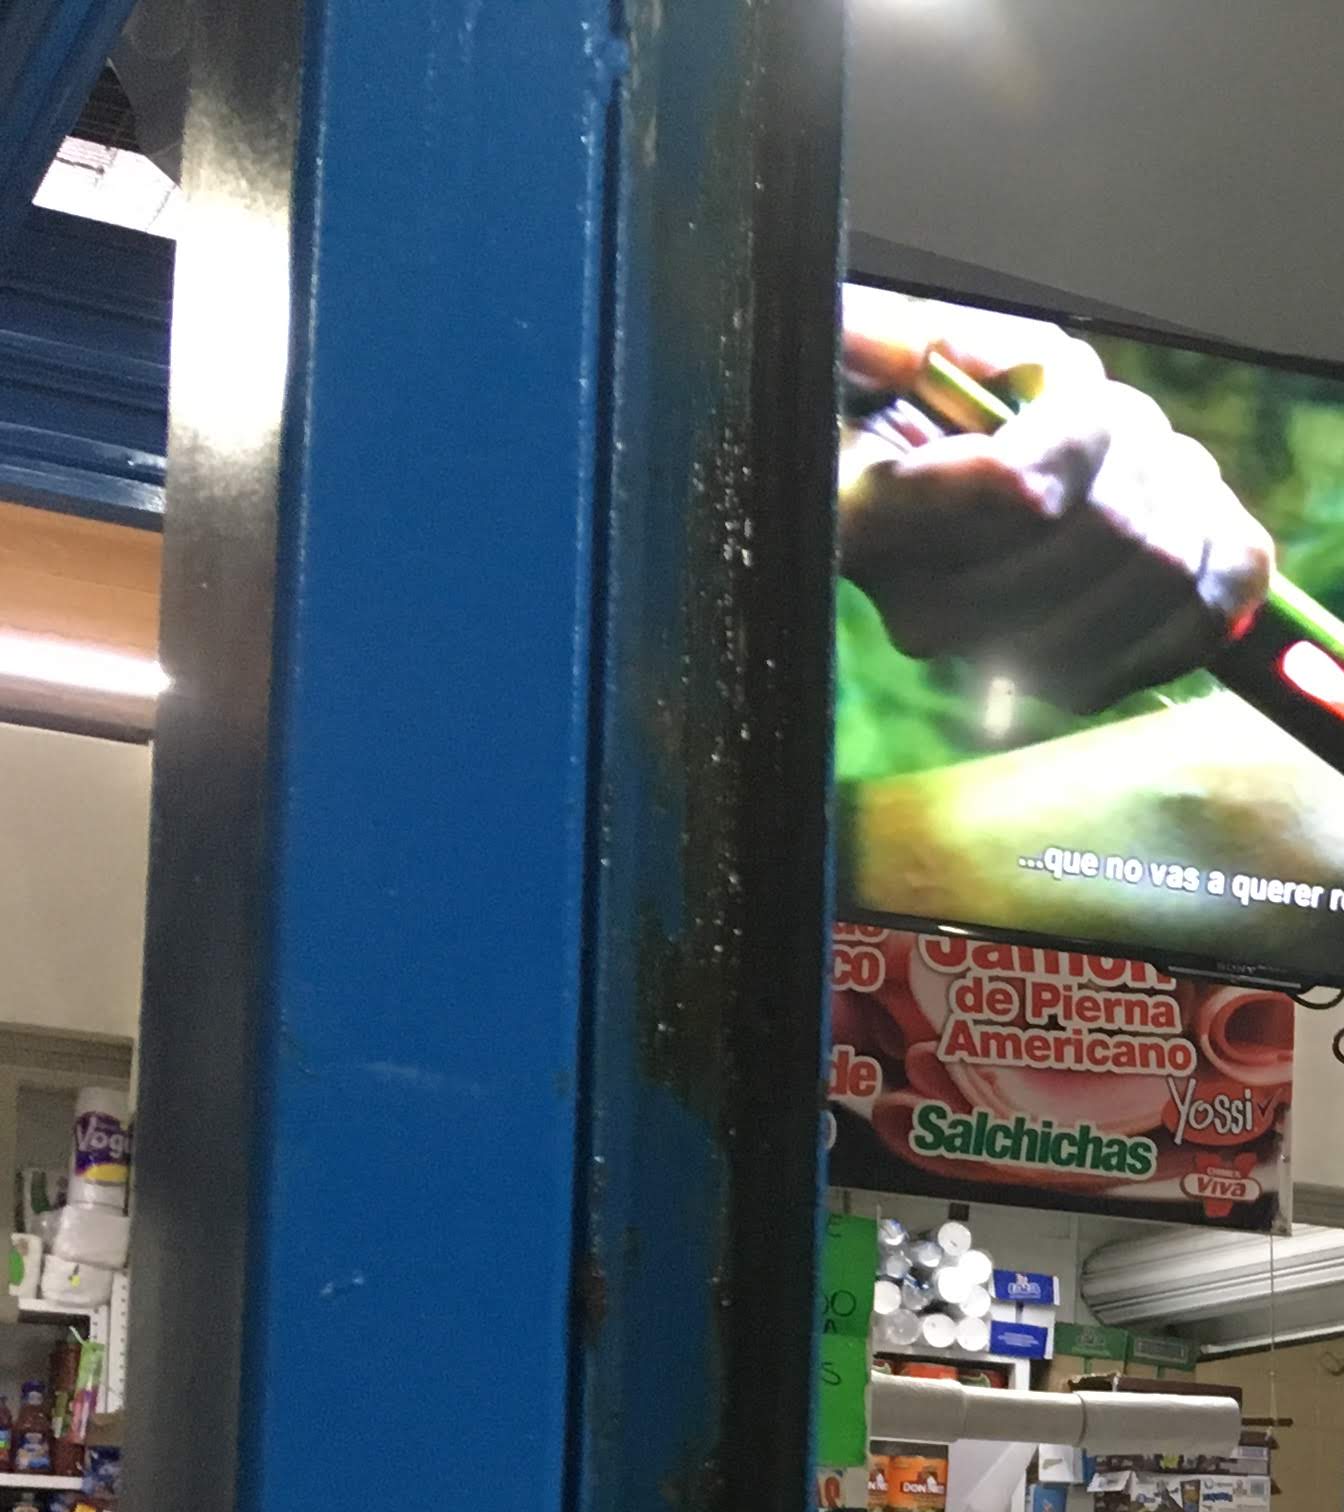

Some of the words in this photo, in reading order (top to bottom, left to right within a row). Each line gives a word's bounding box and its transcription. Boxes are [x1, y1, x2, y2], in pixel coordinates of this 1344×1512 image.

[1105, 854, 1143, 884] no
[1150, 862, 1200, 892] vas
[1207, 871, 1225, 895] a
[1231, 874, 1324, 907] querer
[955, 976, 1013, 1016] de
[1031, 981, 1176, 1029] Pierna
[945, 1019, 1193, 1071] Americano
[1167, 1076, 1254, 1145] Yossi
[914, 1104, 1155, 1176] Salchichas
